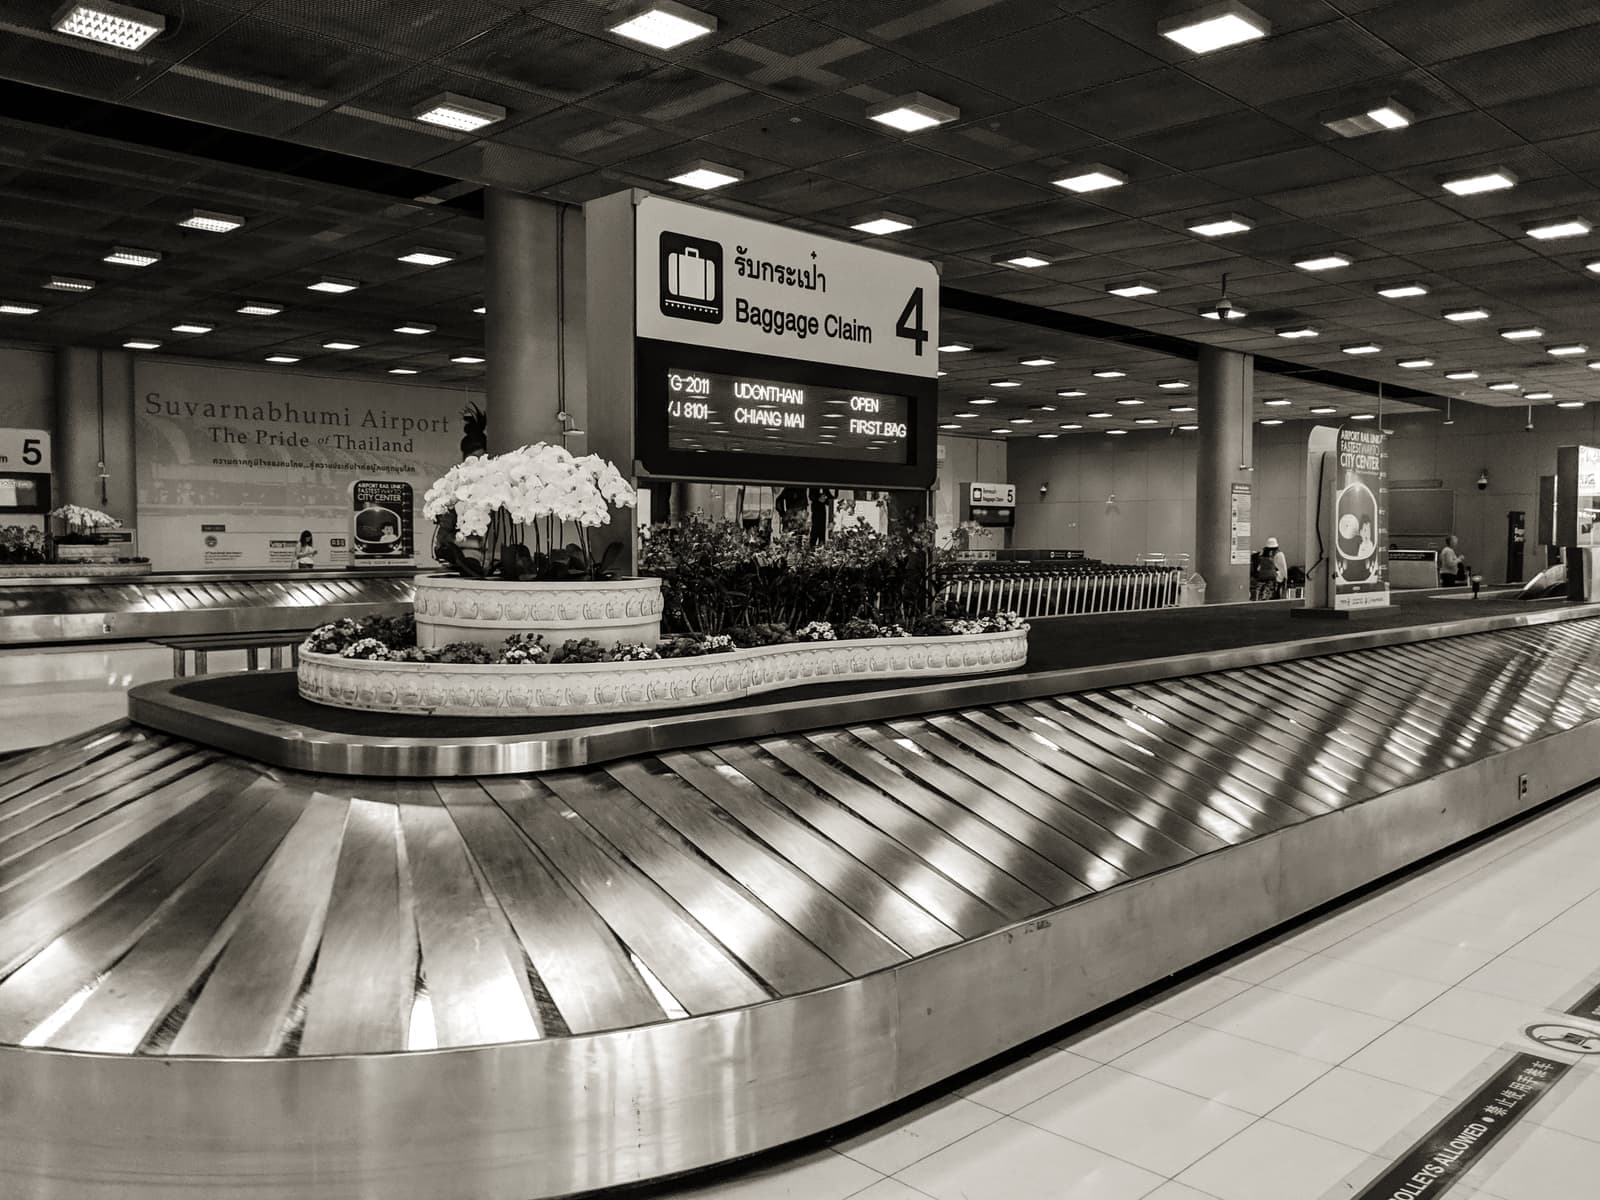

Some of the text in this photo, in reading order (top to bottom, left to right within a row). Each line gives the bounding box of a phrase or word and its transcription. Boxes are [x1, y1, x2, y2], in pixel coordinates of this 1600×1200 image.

[735, 245, 826, 293] รับกระเป๋า
[736, 298, 872, 344] Baggage Claim
[896, 287, 929, 357] 4
[668, 374, 880, 413] G 2011 UDONTHANI OPEN
[145, 392, 450, 437] Suvarnabhumi Airport
[683, 401, 708, 420] 8101
[734, 407, 783, 427] CHIANG
[784, 412, 806, 429] MAI
[849, 418, 882, 436] FIRST
[883, 421, 907, 438] BAG
[22, 438, 42, 466] 5
[208, 426, 414, 453] The Pride of Thailand
[1341, 430, 1360, 441] AIRPORT
[1341, 441, 1361, 453] FASTEST
[1341, 453, 1379, 470] CITY CENTER
[1007, 489, 1014, 503] 5
[1433, 1123, 1489, 1167] ALLOWED
